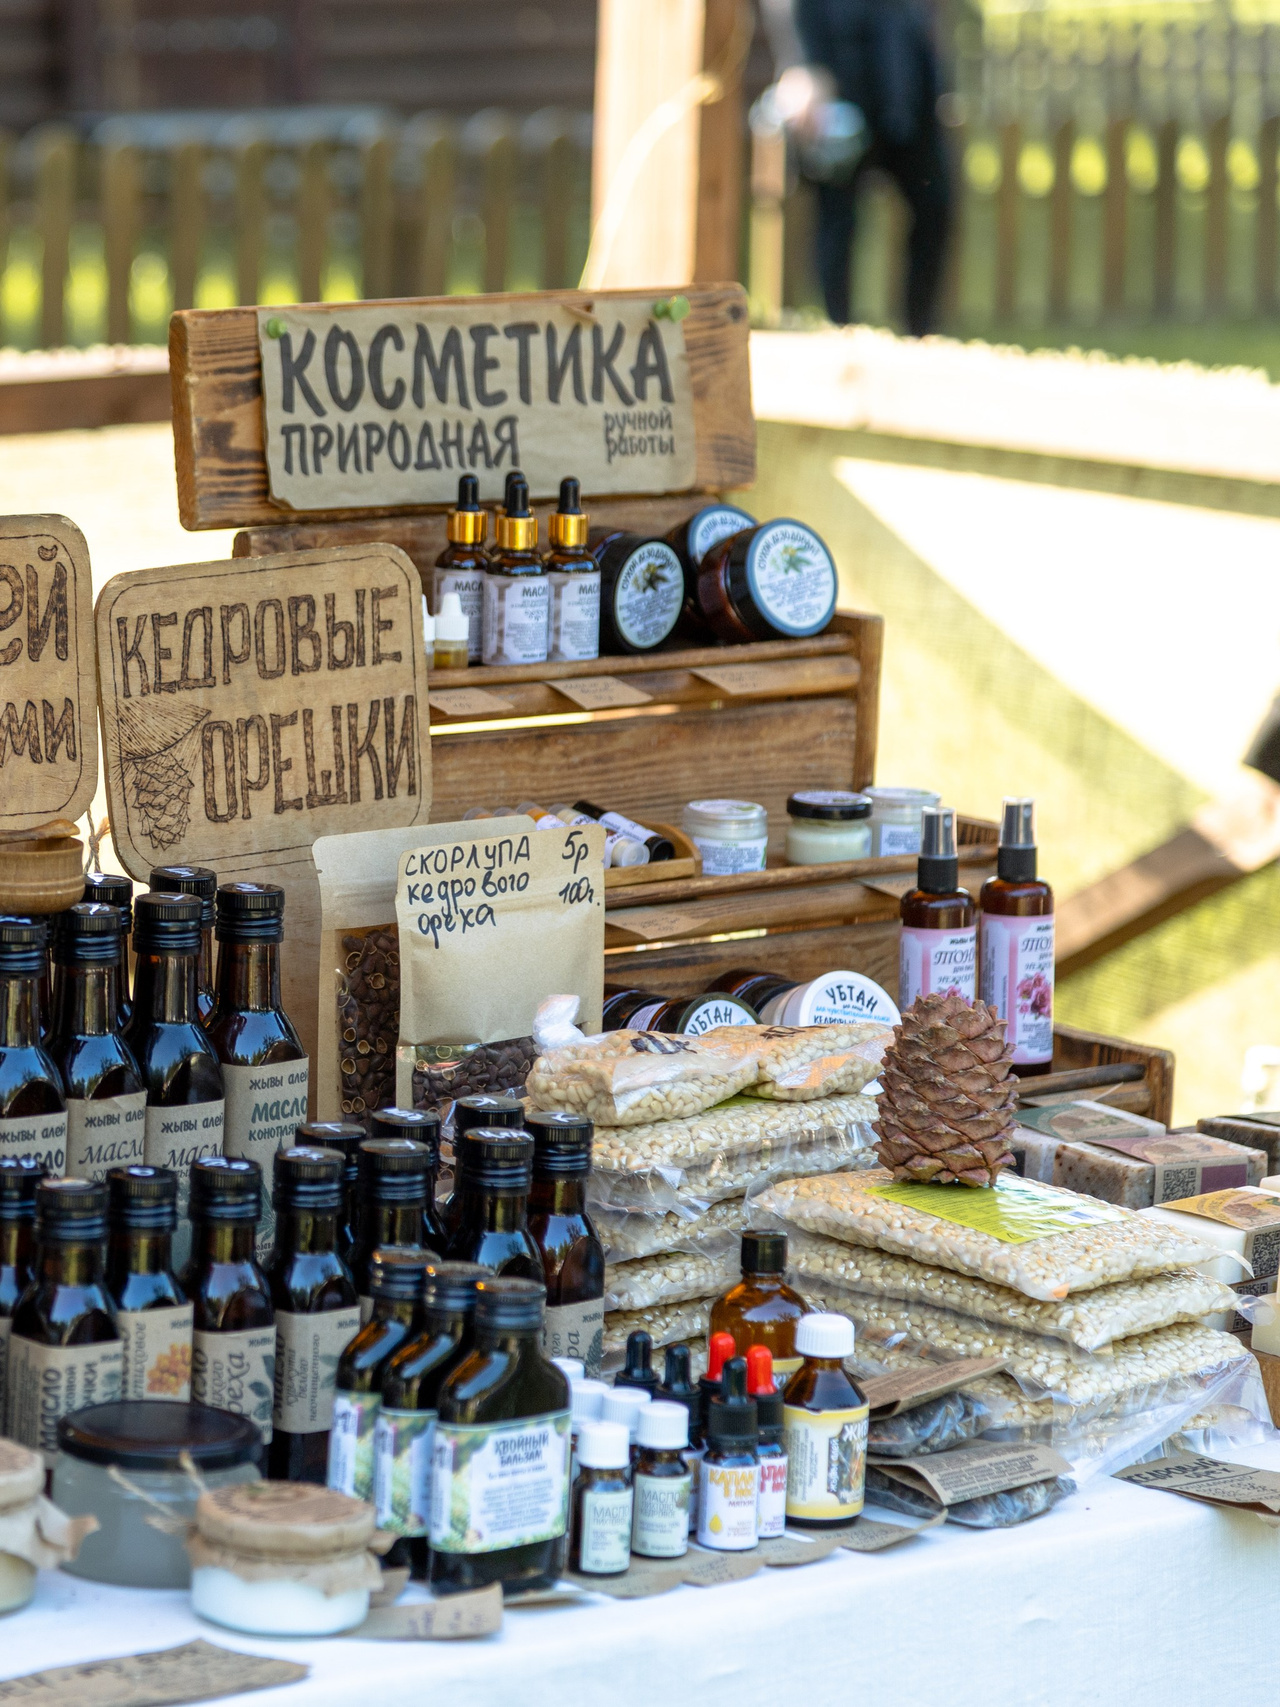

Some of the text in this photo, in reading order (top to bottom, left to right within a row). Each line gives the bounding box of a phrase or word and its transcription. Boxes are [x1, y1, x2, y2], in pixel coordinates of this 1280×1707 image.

[278, 319, 676, 417] КОСМЕТИКА
[280, 413, 519, 476] ПРИРОДНАЯ
[604, 405, 673, 446] ручной
[605, 433, 675, 465] работы
[117, 583, 403, 699] КЕДРОВЫЕ
[202, 694, 417, 823] ОРЕШКИ
[404, 836, 530, 877] СКОРЛУПА
[408, 870, 530, 918] кедрового
[418, 903, 497, 949] ореха
[825, 984, 878, 1013] УБТАН
[688, 1006, 733, 1036] УБТАН
[494, 1430, 549, 1456] ХВОЙНЫЙ
